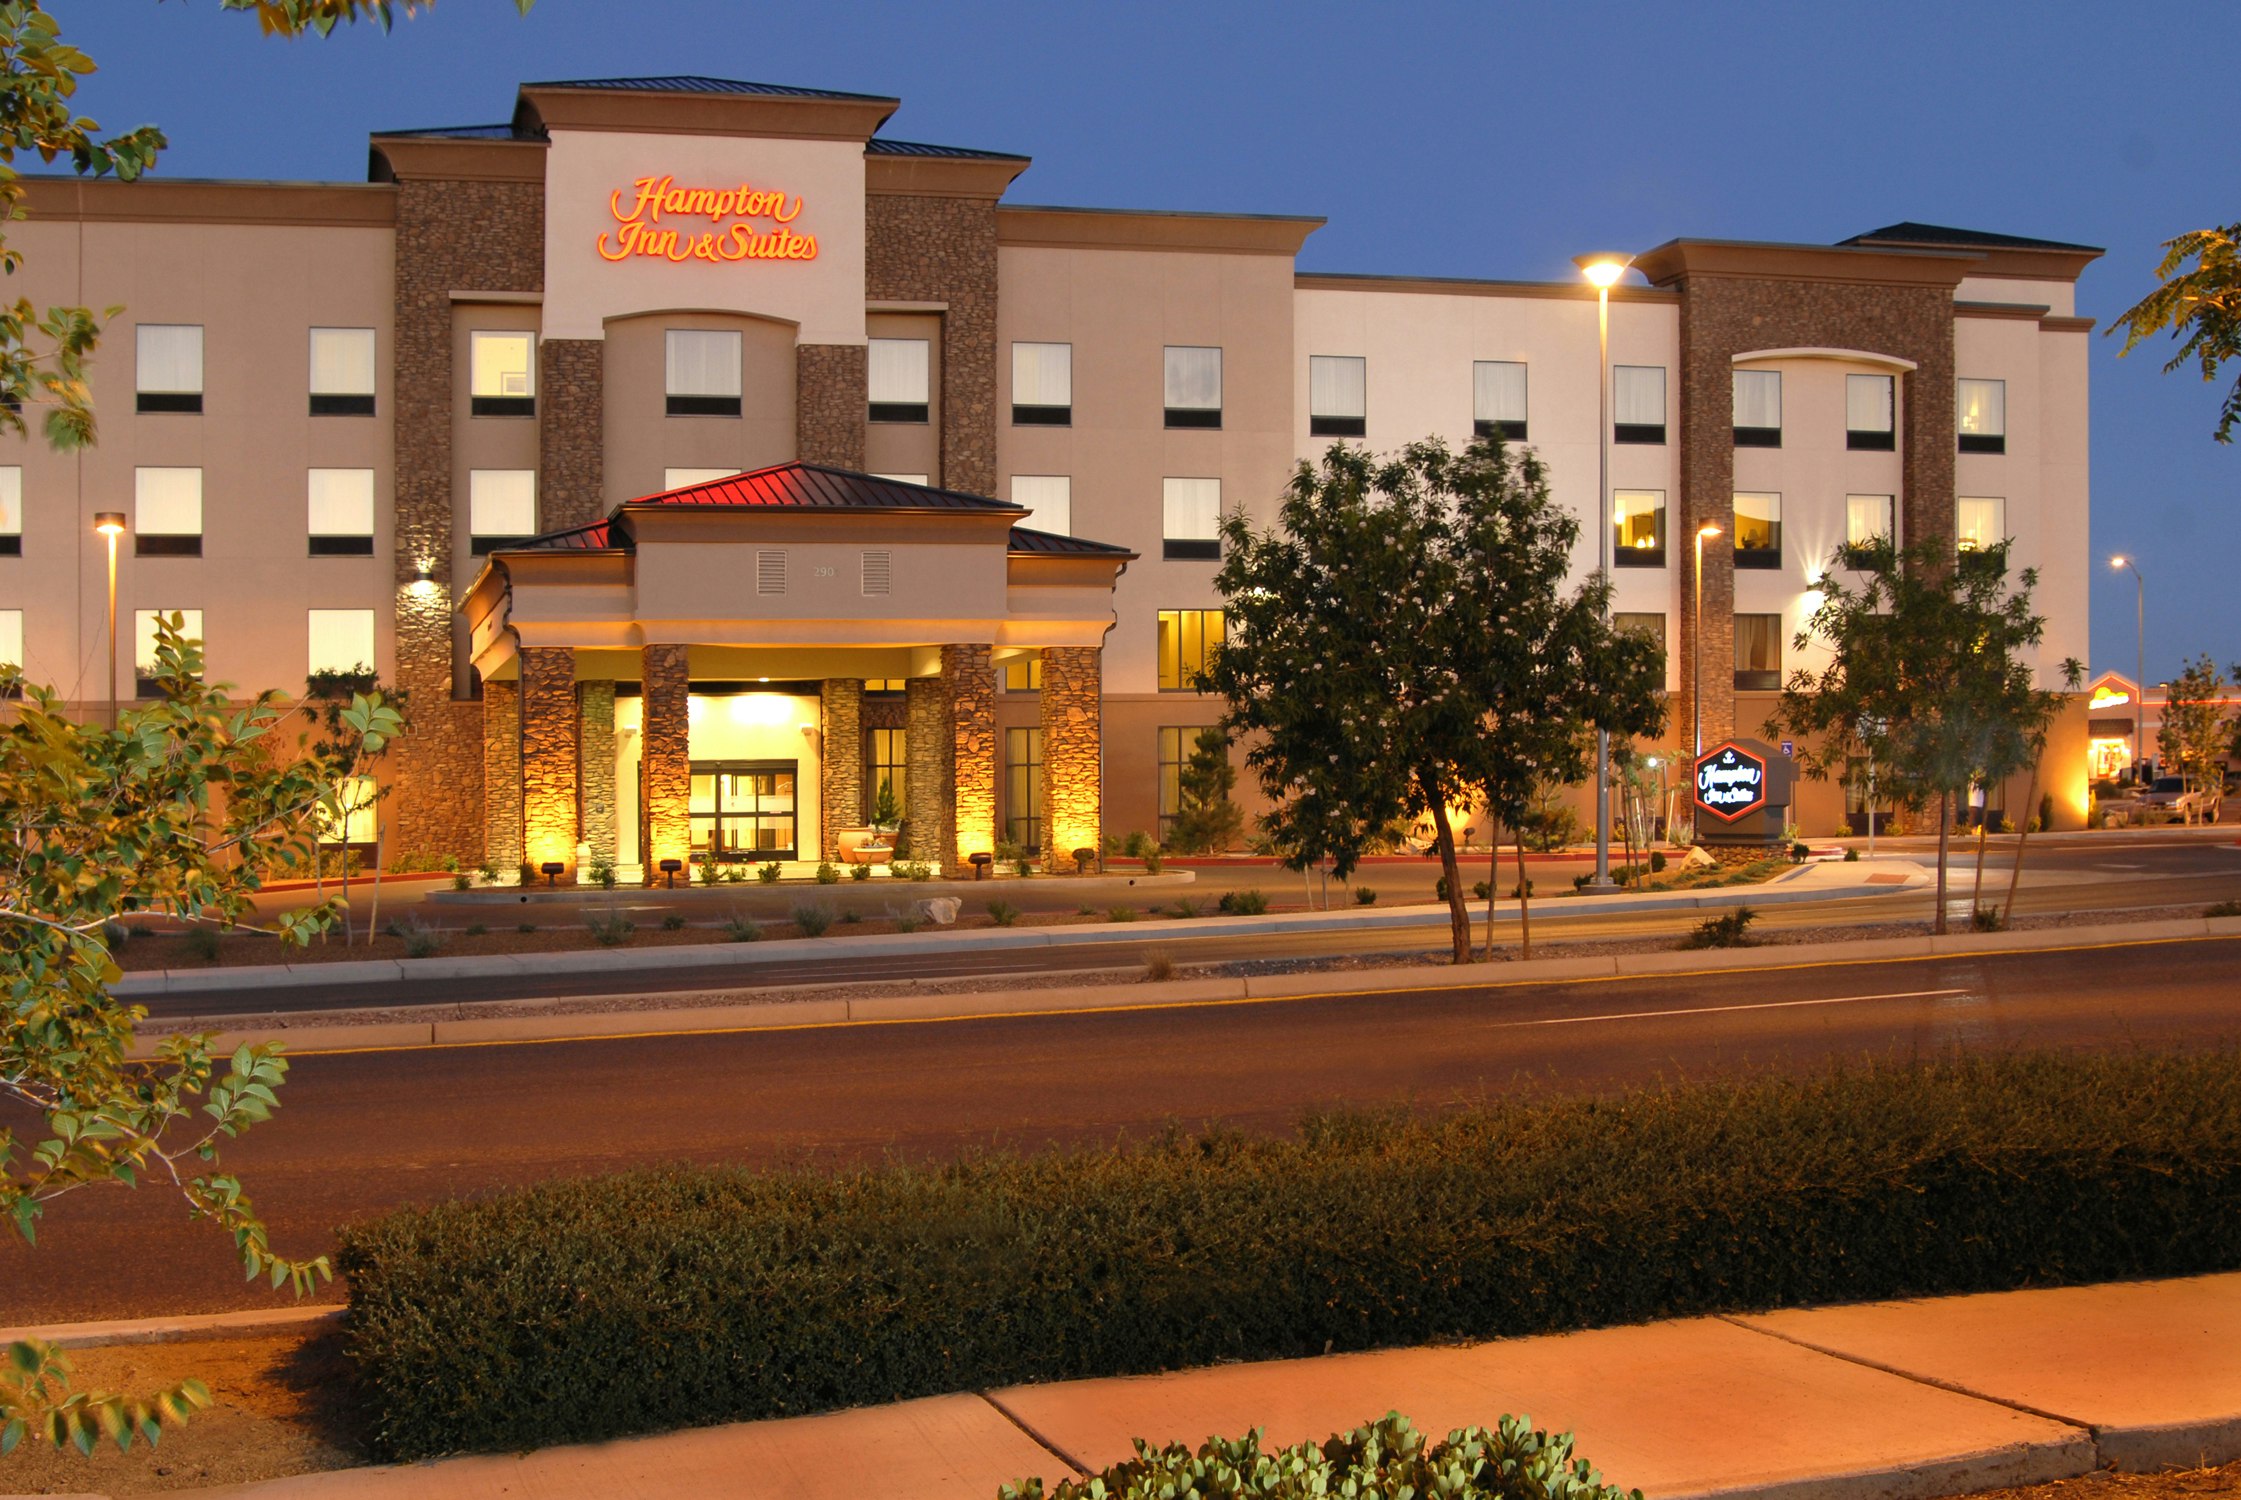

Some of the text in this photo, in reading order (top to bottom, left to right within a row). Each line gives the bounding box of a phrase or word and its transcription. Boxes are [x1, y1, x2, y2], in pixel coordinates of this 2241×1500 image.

[610, 175, 802, 223] Hampton
[598, 221, 818, 262] Inn & Suites
[813, 566, 834, 577] 290
